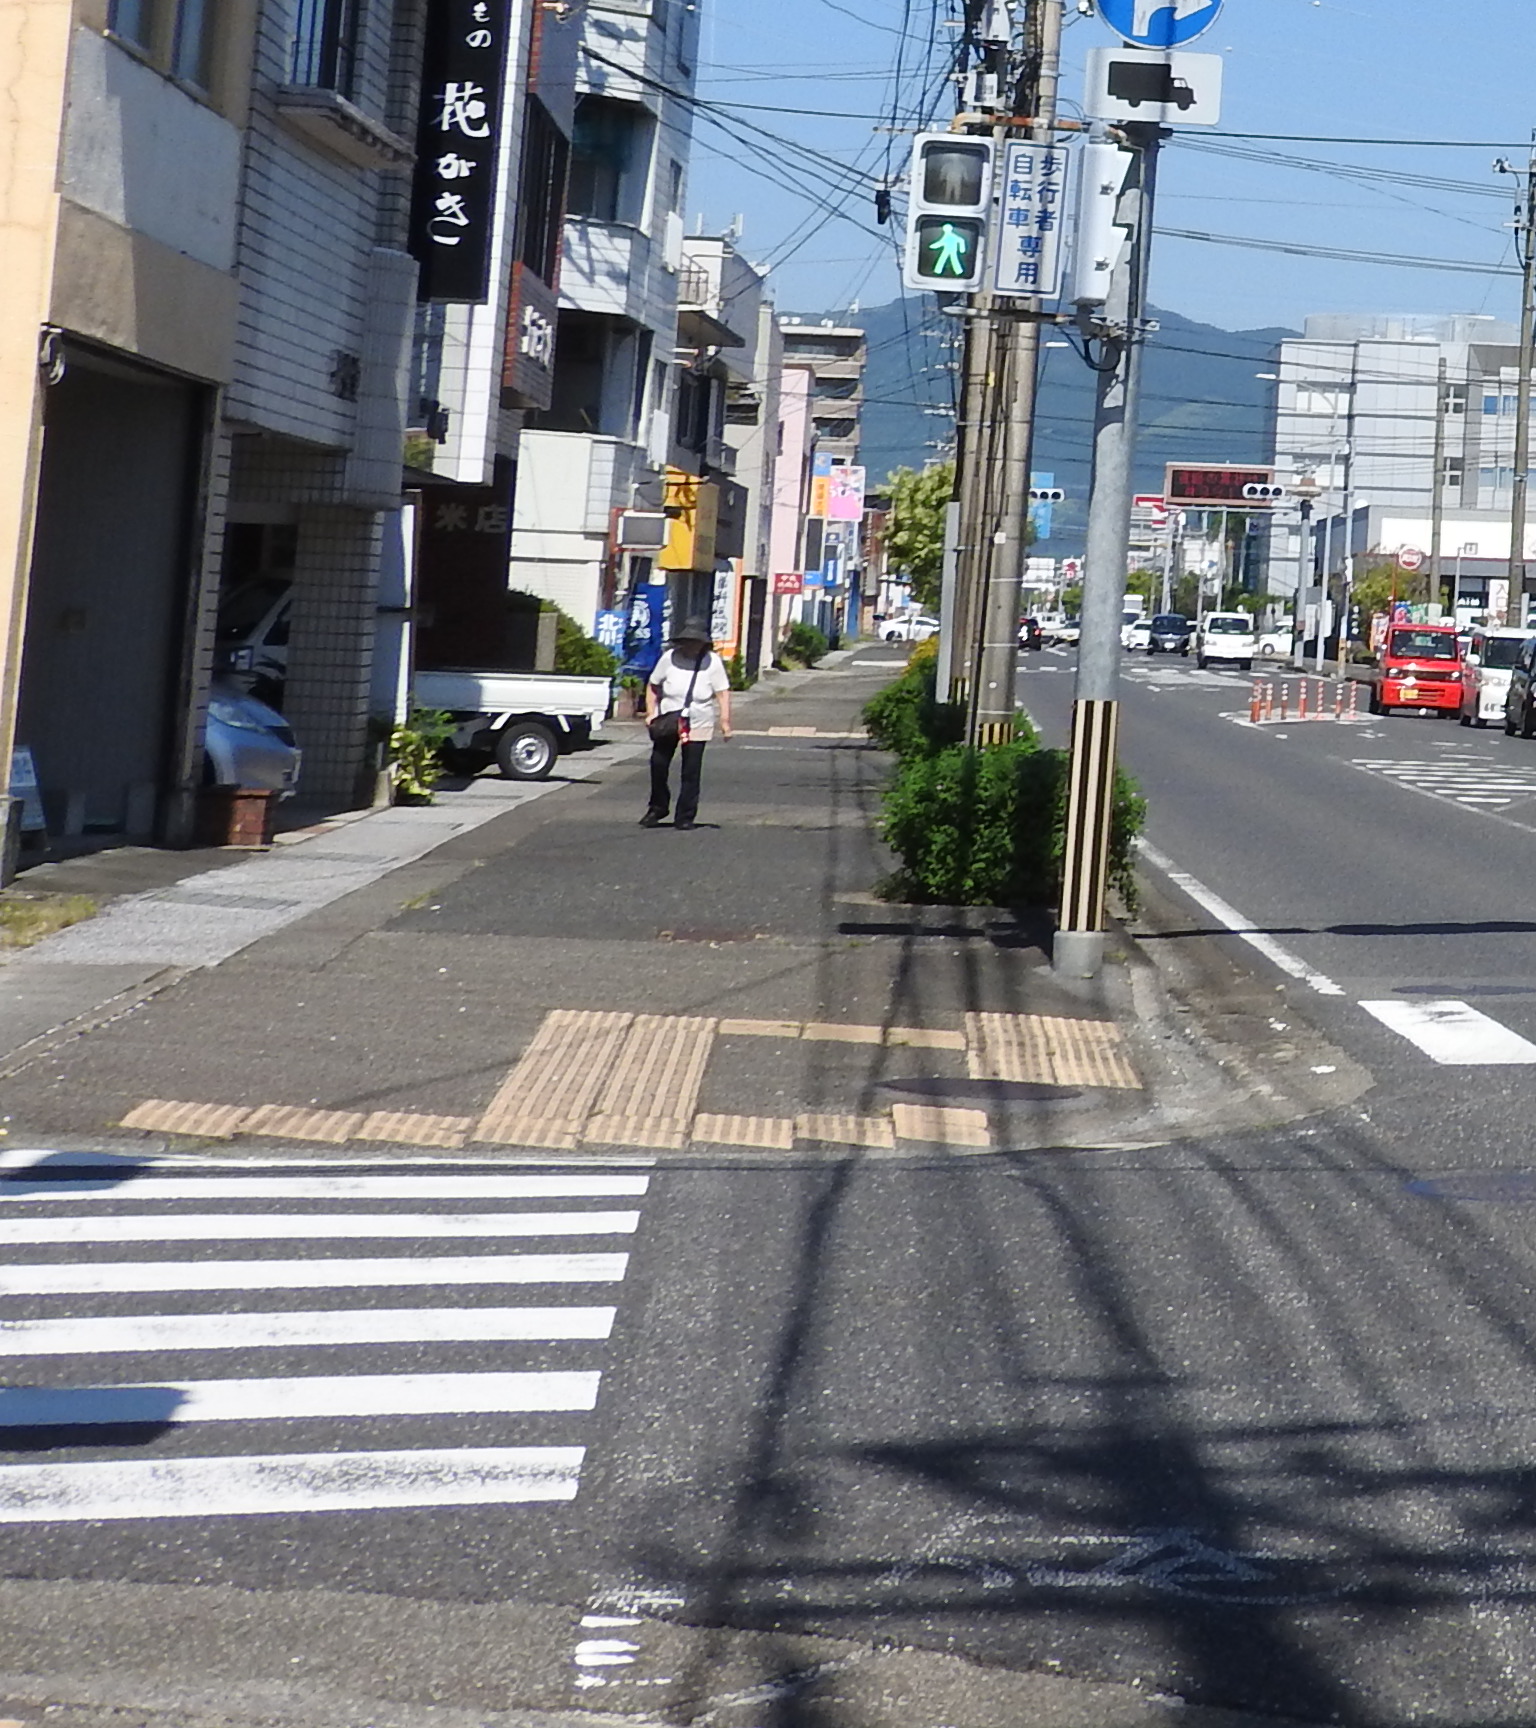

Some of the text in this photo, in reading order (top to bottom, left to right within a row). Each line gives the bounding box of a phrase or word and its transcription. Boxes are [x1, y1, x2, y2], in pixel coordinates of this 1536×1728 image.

[427, 81, 491, 246] 花がき
[1006, 153, 1034, 229] 自転車
[1034, 153, 1063, 232] 歩行者
[1015, 235, 1043, 285] 専用
